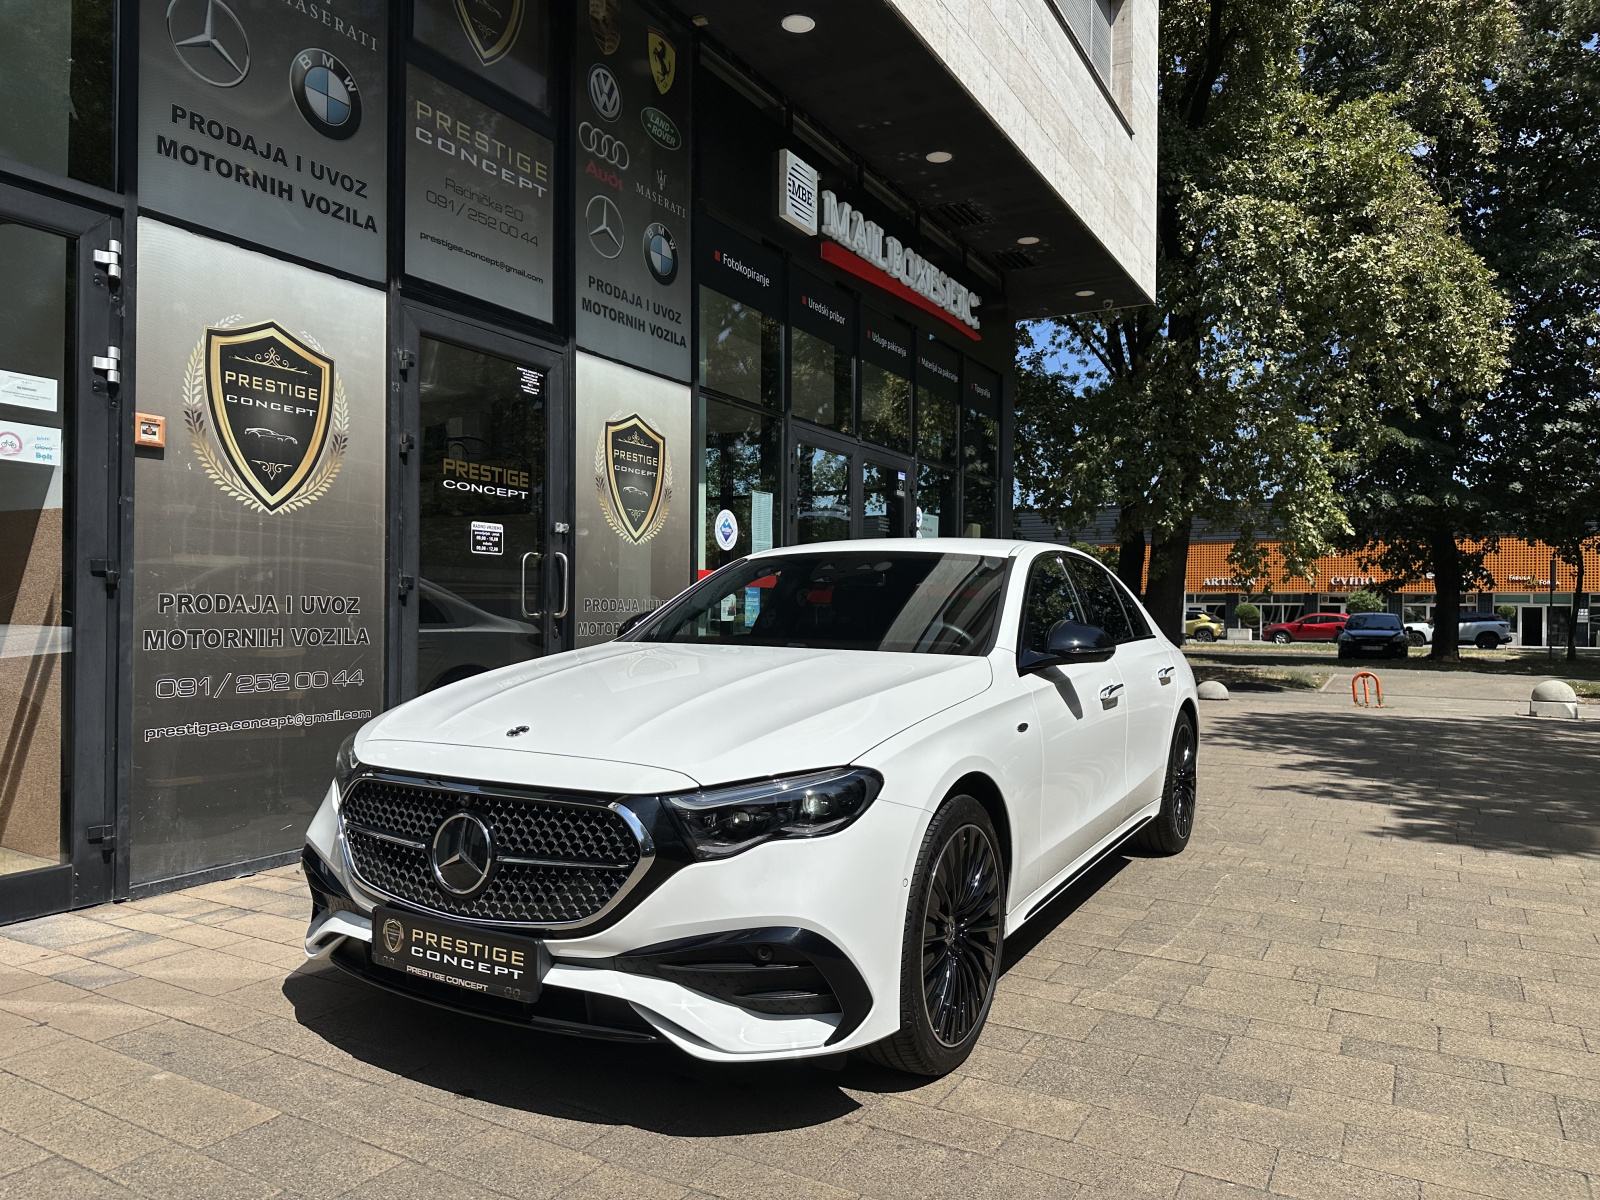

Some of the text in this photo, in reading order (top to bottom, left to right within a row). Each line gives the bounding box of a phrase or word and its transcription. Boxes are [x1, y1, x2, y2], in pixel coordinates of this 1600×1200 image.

[280, 0, 377, 51] ASERATI
[298, 53, 358, 93] BMW
[650, 113, 671, 132] LAND
[651, 125, 677, 147] ROVER
[171, 103, 368, 199] PRODAJA I UVOZ
[415, 99, 548, 182] PRESTIGE
[415, 126, 548, 199] CONCEPT
[586, 161, 624, 191] Audi
[157, 134, 378, 234] MOTORNIH VOZILA
[445, 177, 524, 222] Radnička 20
[636, 181, 686, 218] MASERATI
[791, 180, 813, 207] MBE
[426, 190, 454, 212] 091
[467, 207, 497, 231] 252
[500, 221, 519, 239] 00
[520, 232, 539, 247] 44
[646, 225, 677, 250] BMW
[821, 189, 888, 271] MAIL
[886, 236, 948, 307] BOXES
[419, 231, 544, 284] prestigee.concept@gmail.com
[723, 253, 770, 287] Fotokopiranje
[588, 275, 682, 325] PRODAJA I UVOZ
[808, 297, 846, 325] Uredski pribor
[582, 297, 687, 348] MOTORNIH VOZILA
[224, 370, 319, 401] PRESTIGE
[225, 394, 317, 417] CONCEPT
[442, 458, 529, 488] PRESTIGE
[613, 449, 659, 468] PRESTIGE
[614, 464, 658, 478] CONCEPT
[442, 479, 529, 500] CONCEPT
[158, 593, 360, 615] PRODAJA I UVOZ
[583, 598, 640, 613] PRODAJA
[143, 627, 370, 651] MOTORNIH VOZILA
[577, 621, 621, 637] MOTOR
[155, 676, 210, 699] 091
[235, 673, 290, 694] 252
[295, 670, 328, 690] 00
[332, 668, 364, 687] 44
[144, 709, 371, 742] prestigee.concept@gmail.com
[410, 946, 524, 980] CONCEPT
[411, 928, 525, 967] PRESTIGE
[406, 965, 489, 992] PRESTIGE CONCEPT
